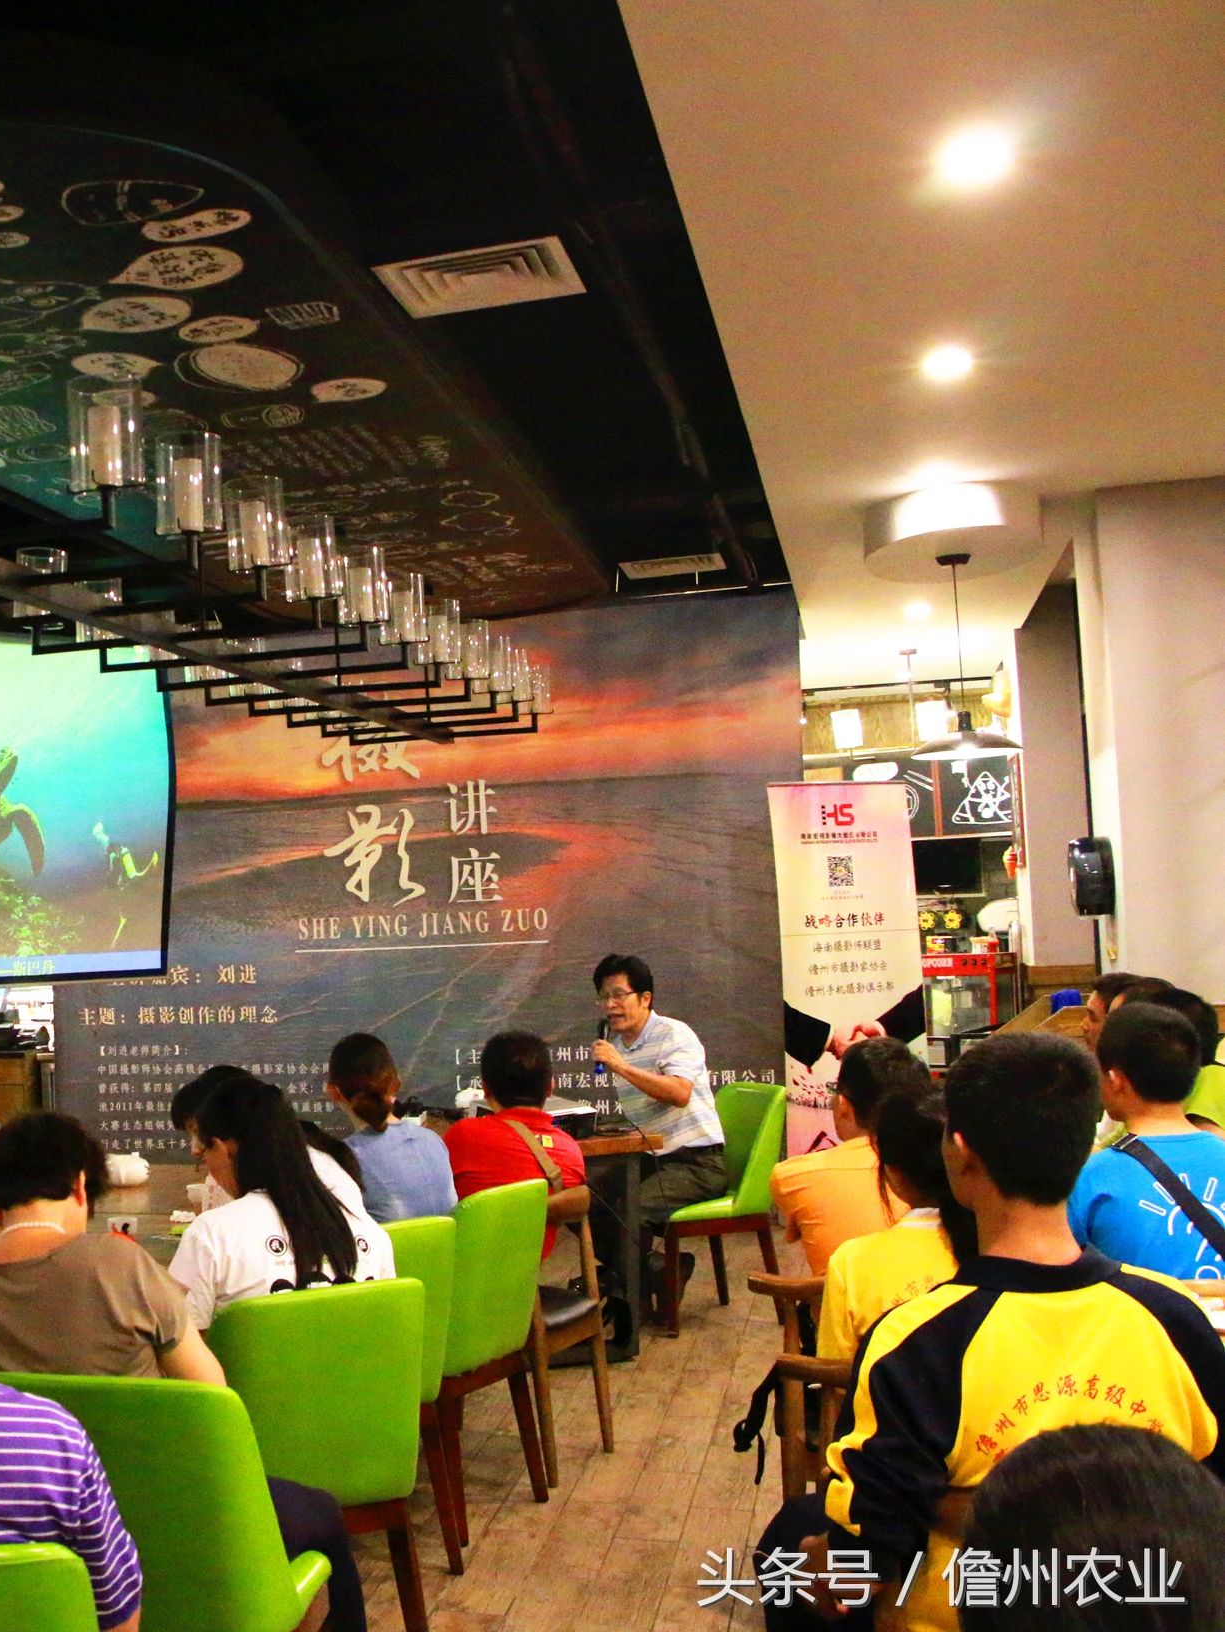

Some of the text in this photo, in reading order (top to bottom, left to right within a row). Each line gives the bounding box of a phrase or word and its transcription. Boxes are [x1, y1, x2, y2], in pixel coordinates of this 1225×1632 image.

[444, 779, 503, 904] 讲座
[298, 907, 548, 940] SHE YING JIANG ZUO
[804, 912, 885, 929] 战略合作伙伴
[550, 1045, 591, 1063] 州市
[553, 1072, 623, 1089] 南宏视
